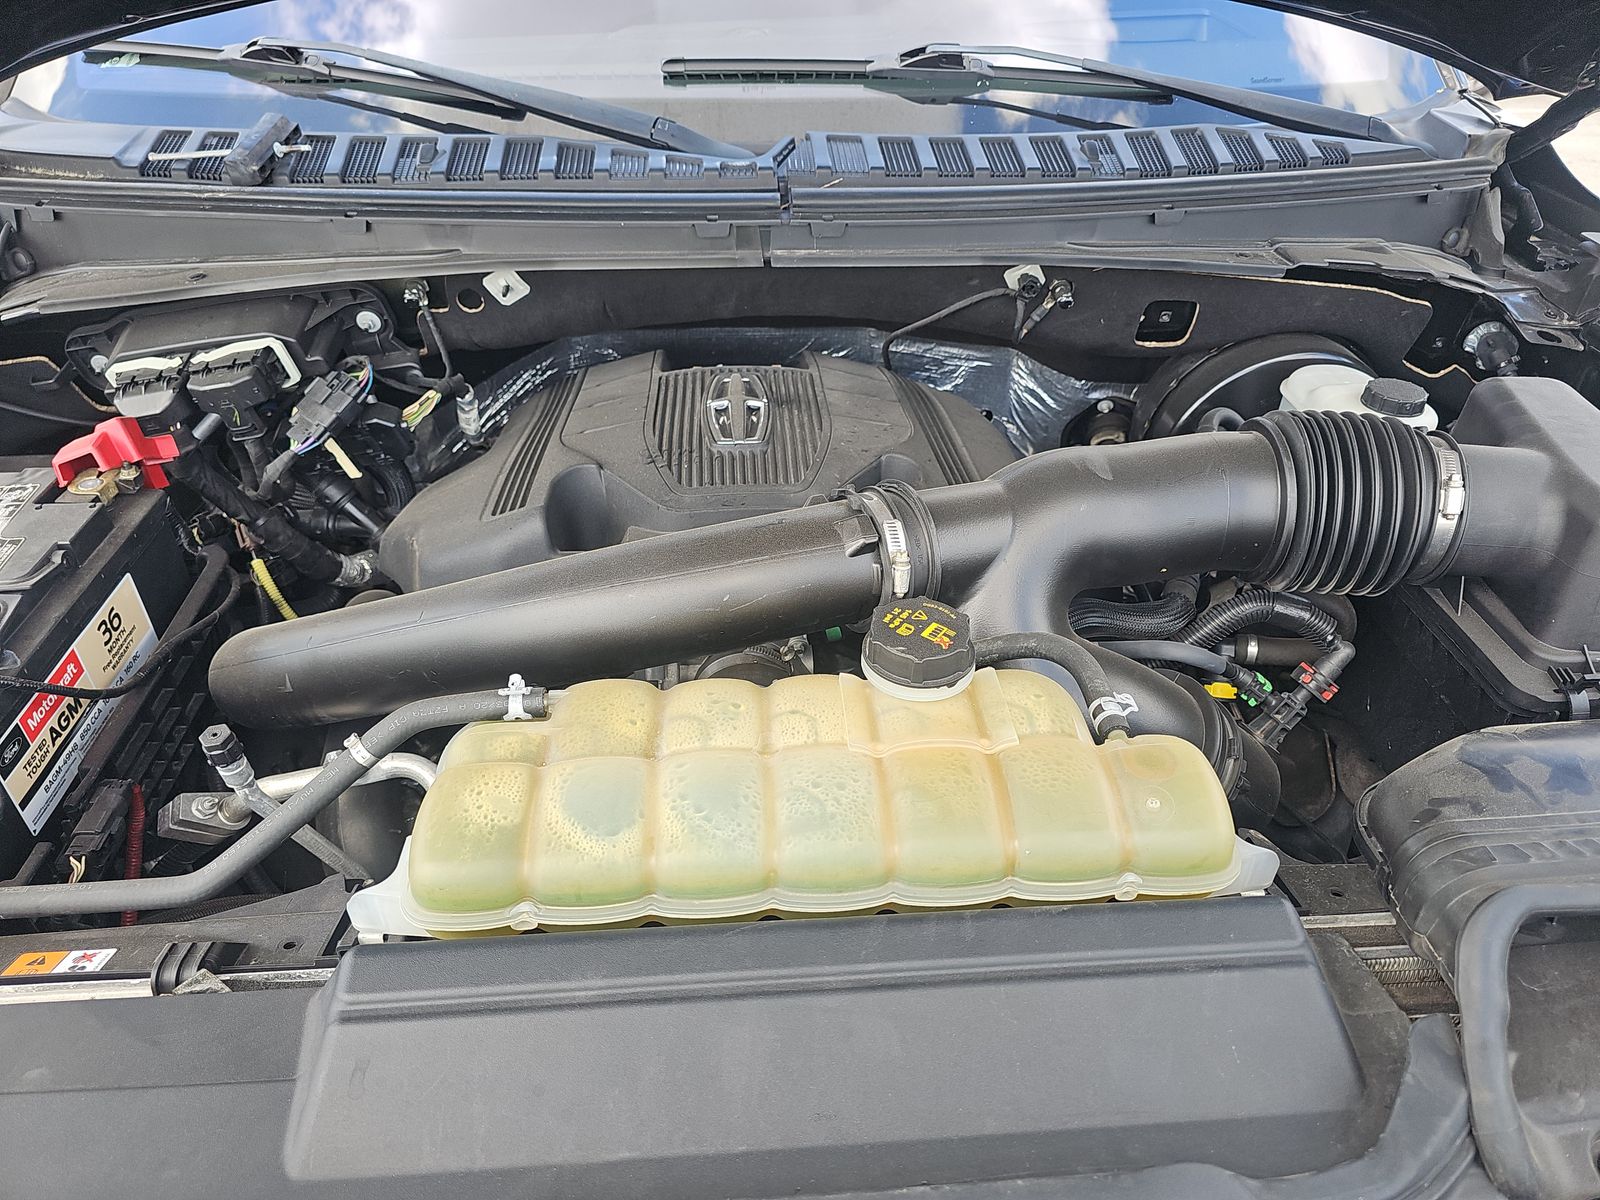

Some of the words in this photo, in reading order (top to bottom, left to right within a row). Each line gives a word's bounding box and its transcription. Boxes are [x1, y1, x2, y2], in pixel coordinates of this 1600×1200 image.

[97, 606, 122, 647] 36
[107, 626, 127, 656] MONTH
[102, 659, 113, 673] Free
[111, 624, 137, 660] Replacement
[111, 636, 135, 671] WARRANTY
[43, 742, 79, 794] BAGM-49H8
[80, 723, 92, 741] 850
[91, 708, 103, 726] CCA
[123, 660, 134, 676] 160
[132, 650, 141, 664] RC
[49, 697, 84, 748] AGM
[22, 738, 48, 772] TESTED
